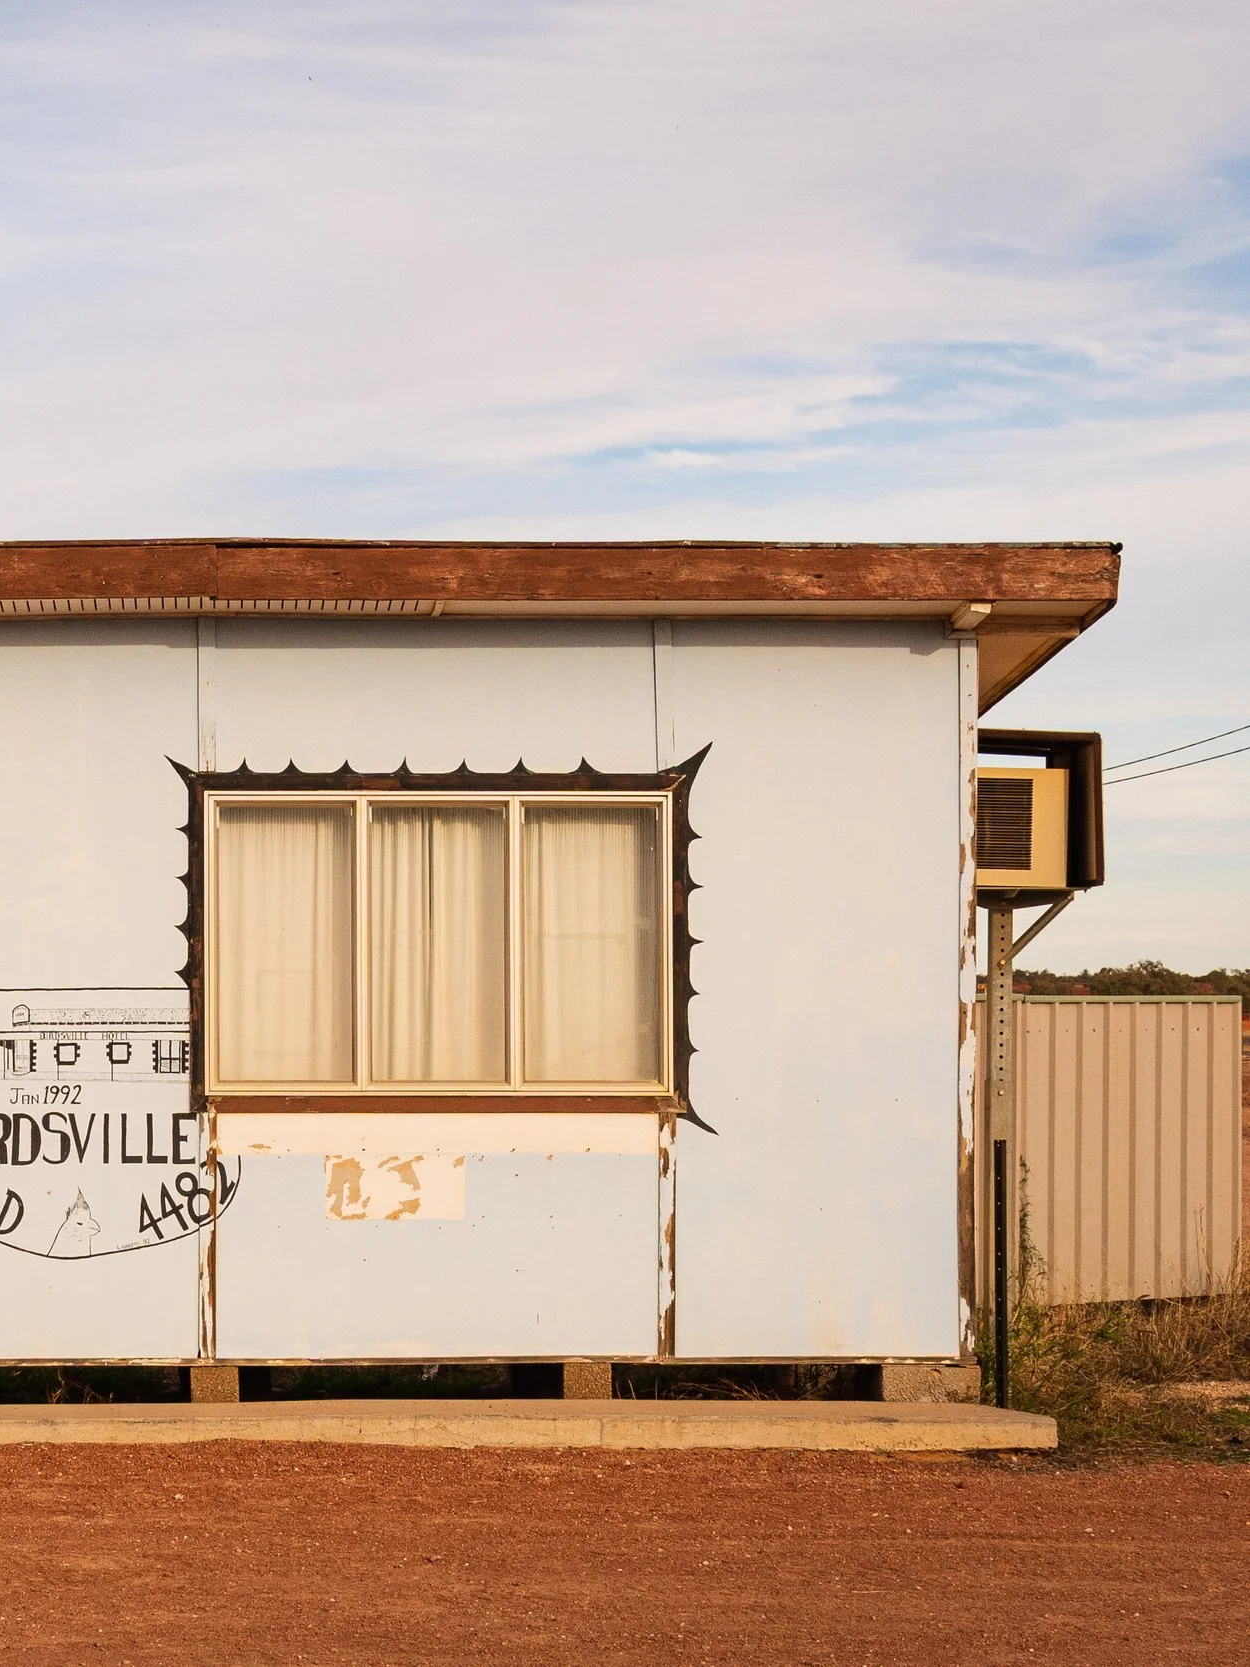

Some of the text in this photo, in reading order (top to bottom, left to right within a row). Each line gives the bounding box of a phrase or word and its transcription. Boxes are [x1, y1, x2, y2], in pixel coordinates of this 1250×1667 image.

[39, 1031, 130, 1041] BIRDSVILLE HOTEL
[43, 1084, 82, 1105] 1992
[139, 1160, 236, 1240] 4482
